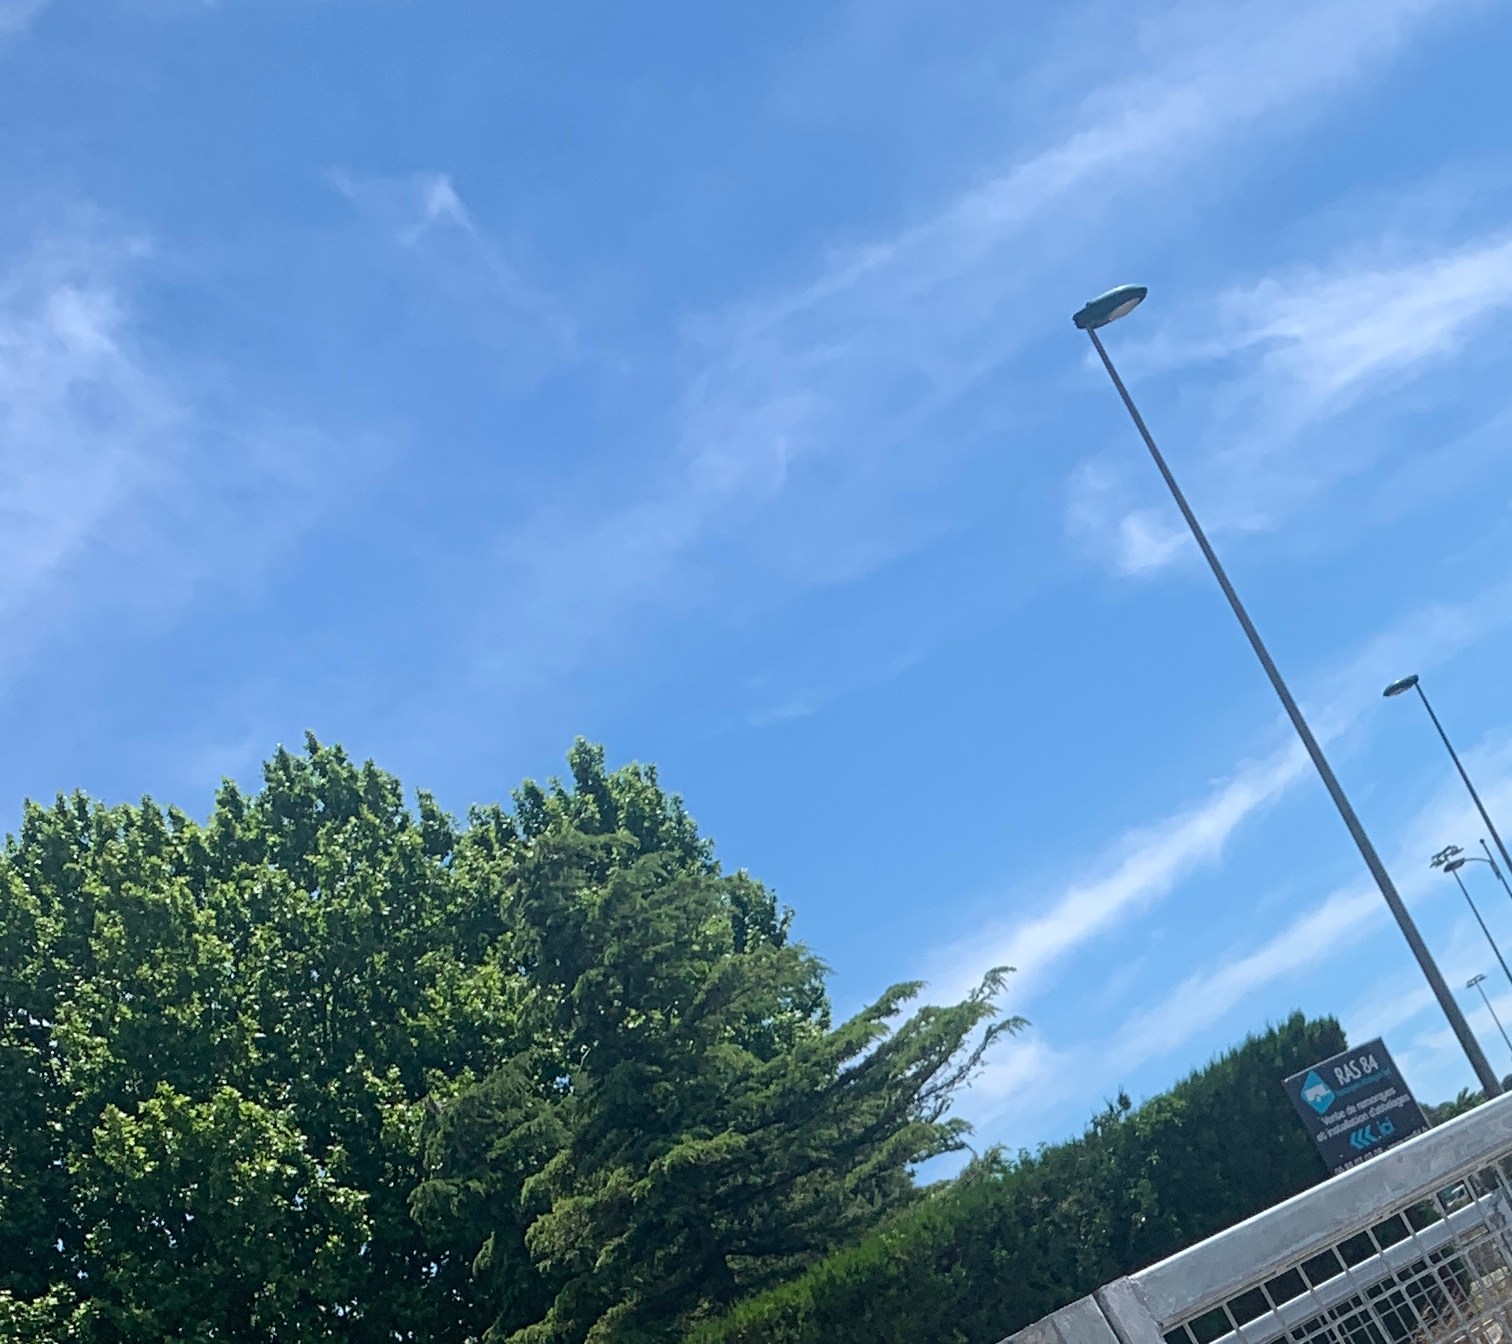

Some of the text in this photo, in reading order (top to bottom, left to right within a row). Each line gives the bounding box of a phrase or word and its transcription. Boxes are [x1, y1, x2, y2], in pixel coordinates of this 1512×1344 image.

[1333, 1059, 1363, 1086] RAS
[1360, 1055, 1379, 1074] 84
[1320, 1109, 1346, 1125] Vente
[1345, 1105, 1356, 1117] de
[1316, 1130, 1327, 1143] et
